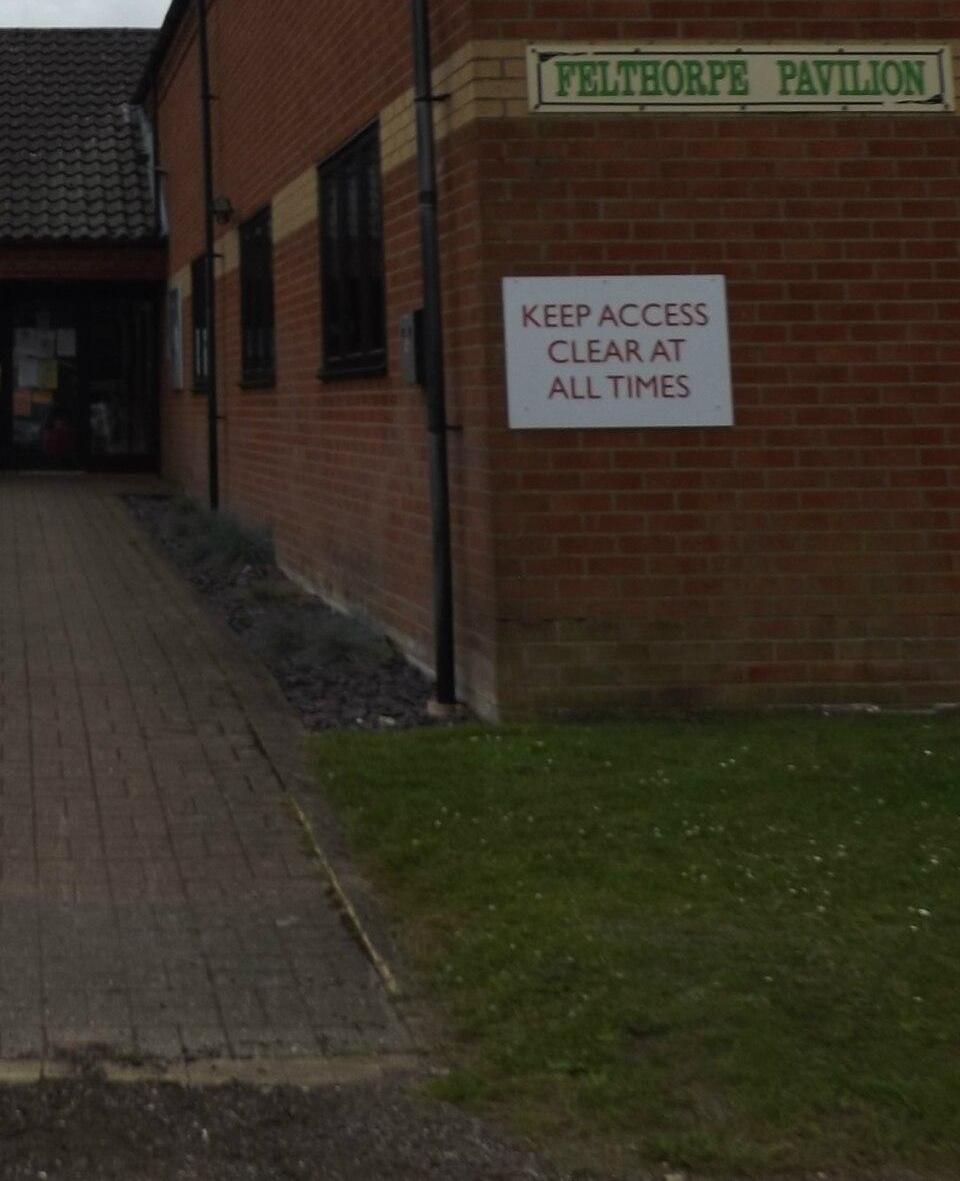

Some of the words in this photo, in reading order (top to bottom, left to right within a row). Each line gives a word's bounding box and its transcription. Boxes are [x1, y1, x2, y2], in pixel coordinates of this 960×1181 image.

[555, 59, 749, 97] FELTHORPE
[777, 59, 926, 96] PAVILION
[522, 304, 592, 328] KEEP
[598, 303, 709, 327] ACCESS
[548, 340, 643, 364] CLEAR
[649, 339, 686, 362] AT
[548, 376, 601, 400] ALL
[607, 374, 690, 399] TIMES
